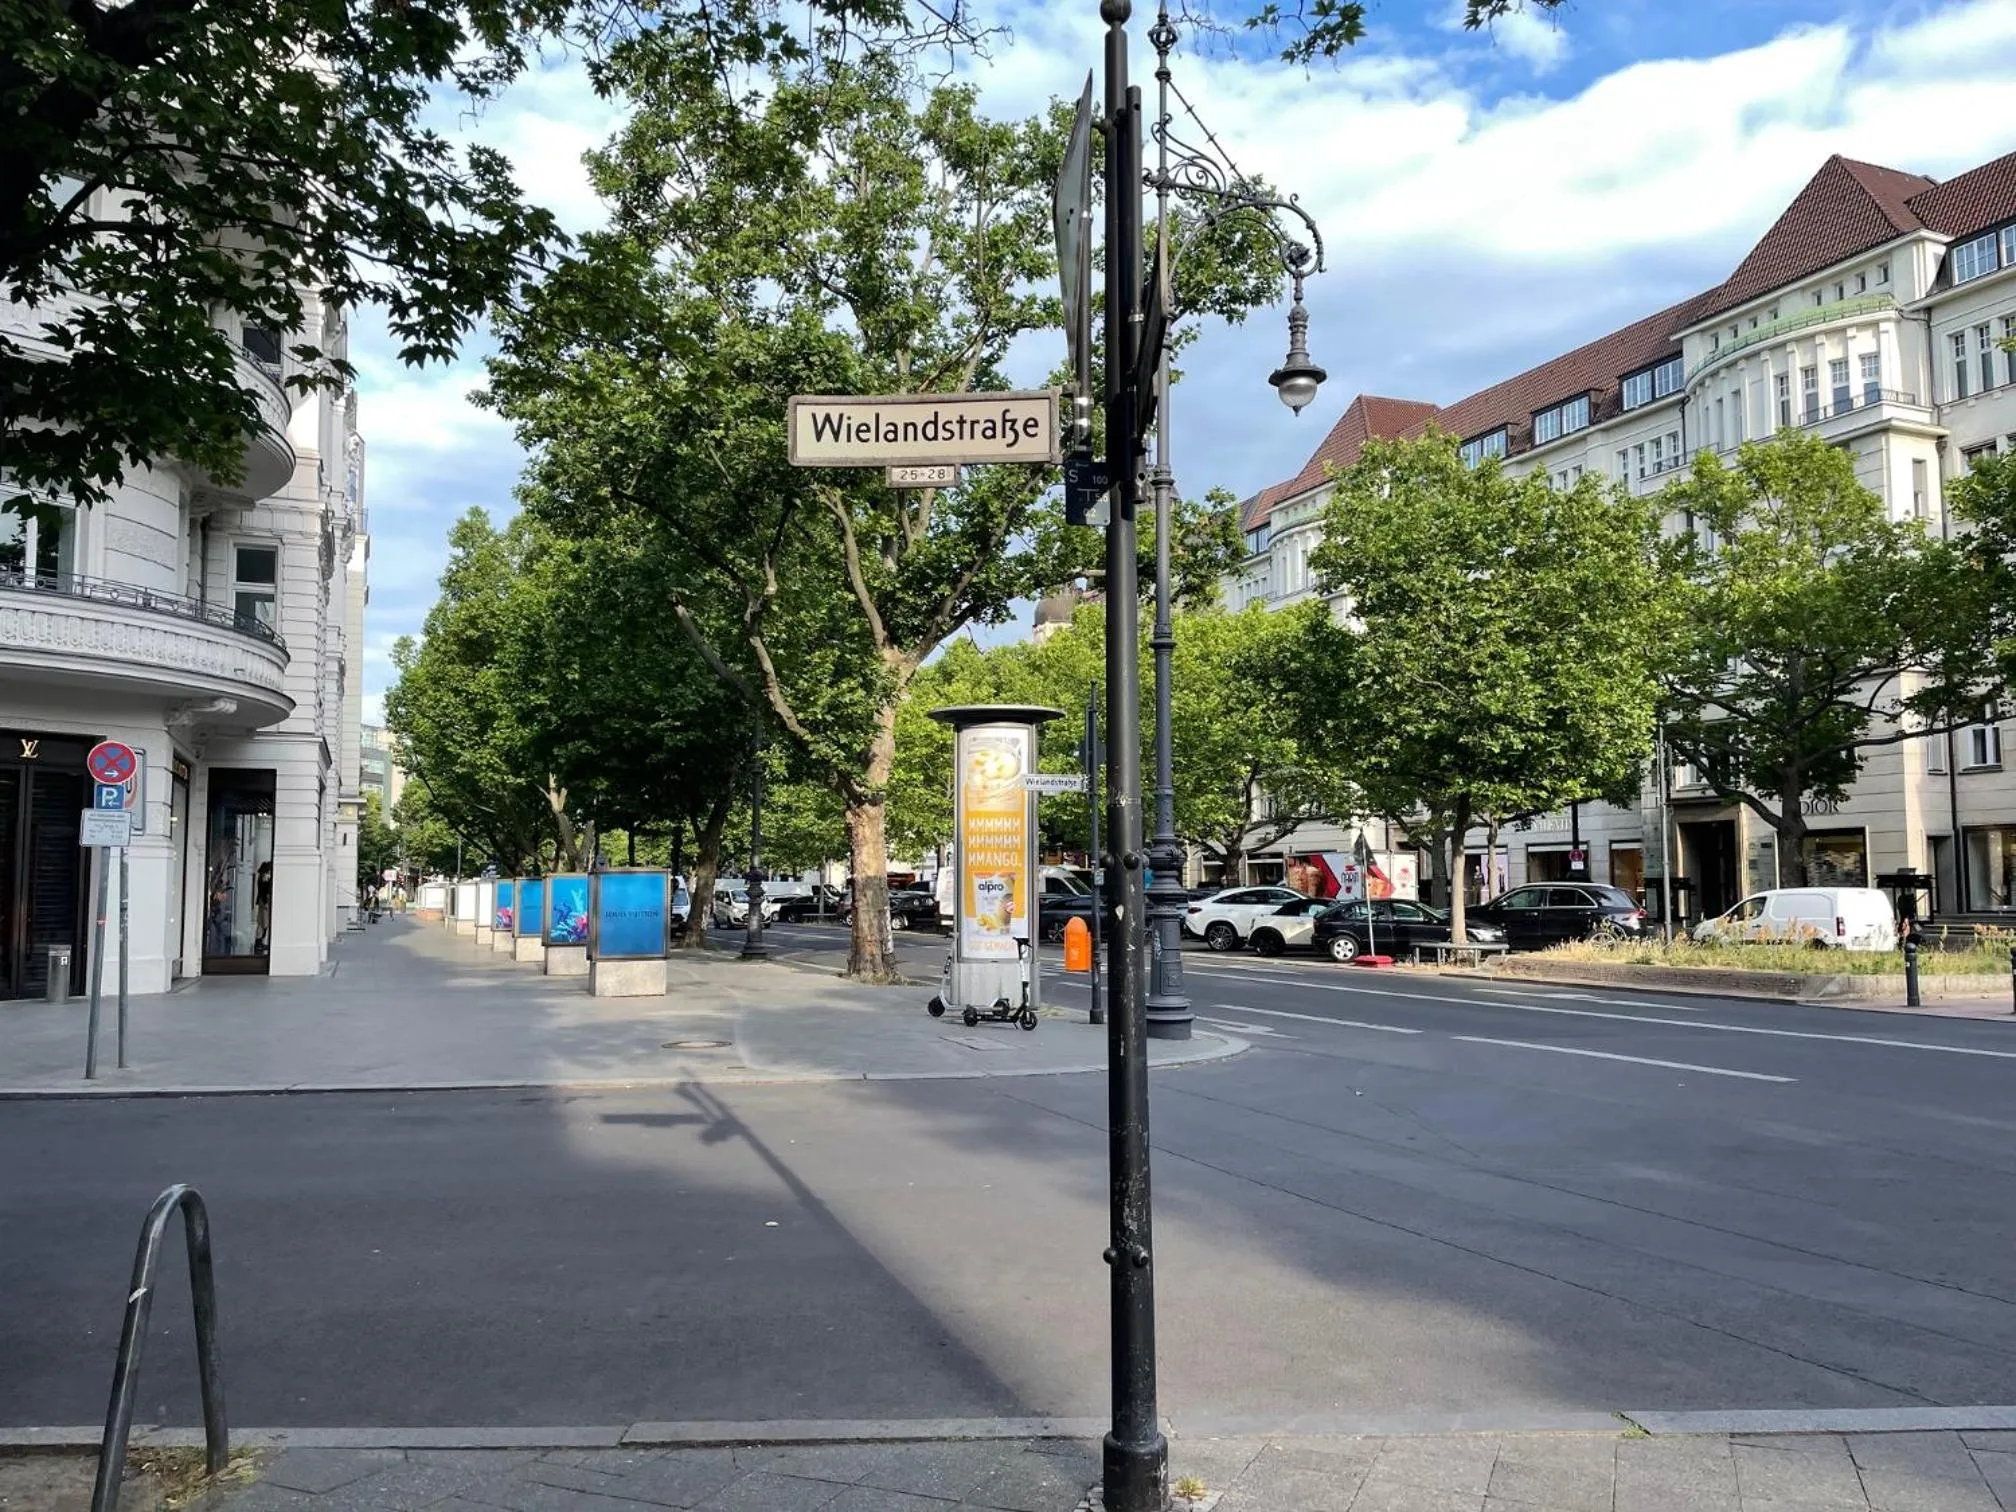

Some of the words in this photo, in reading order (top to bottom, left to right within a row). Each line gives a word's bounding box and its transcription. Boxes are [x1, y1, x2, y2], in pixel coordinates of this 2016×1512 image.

[811, 409, 1039, 448] Wielandstraße
[900, 468, 946, 481] 25-28
[1068, 468, 1079, 484] S
[1093, 474, 1109, 485] 100
[101, 787, 118, 807] P
[977, 879, 1004, 893] alpro
